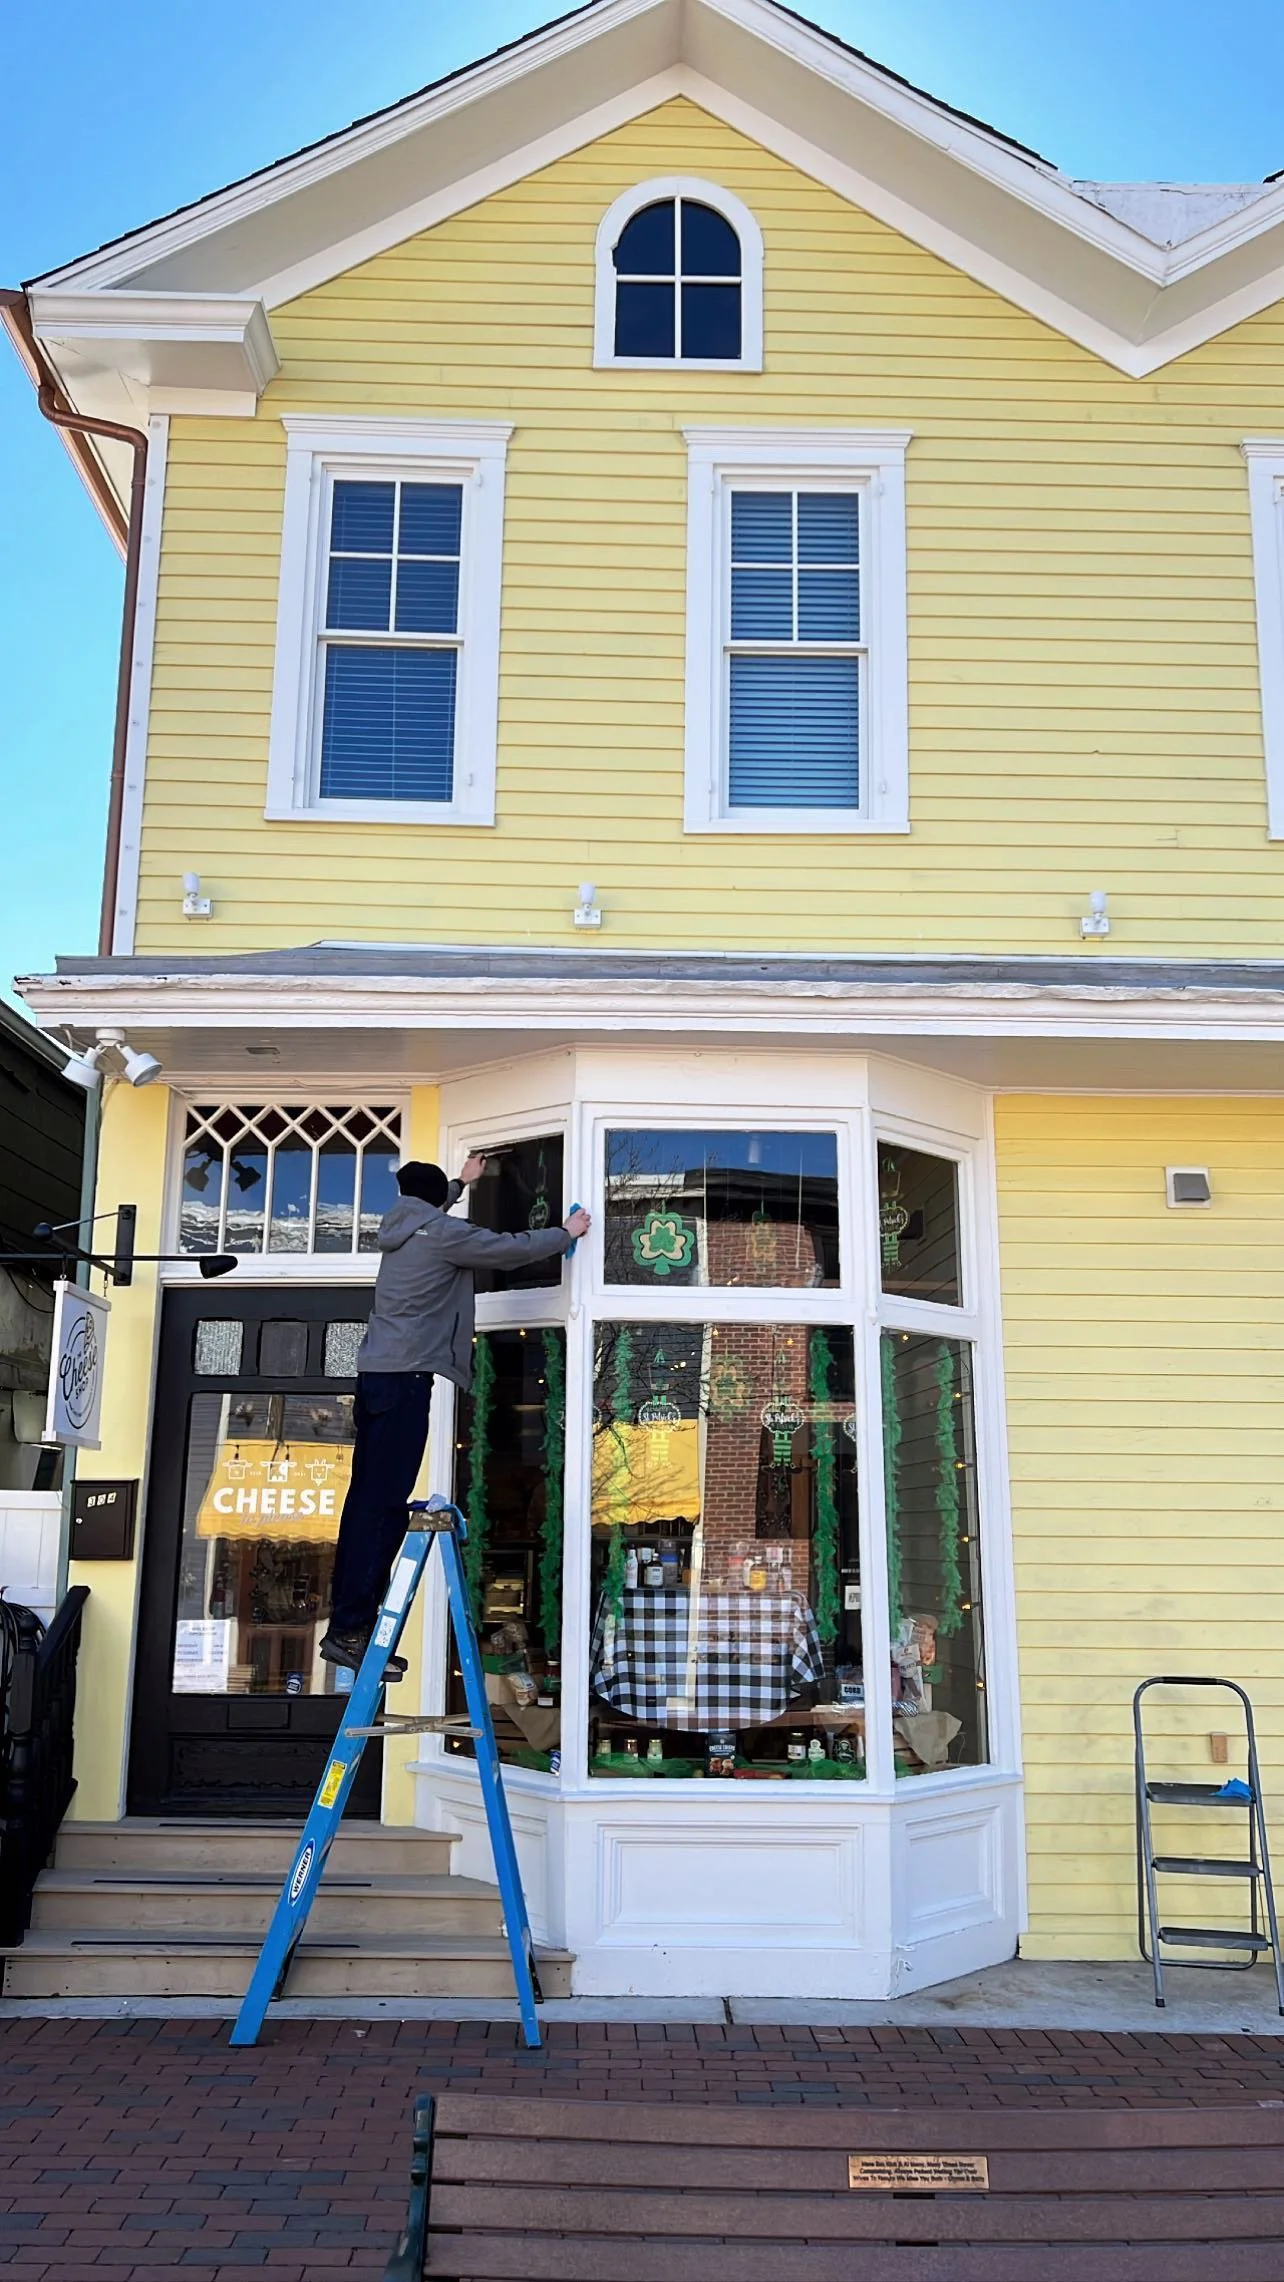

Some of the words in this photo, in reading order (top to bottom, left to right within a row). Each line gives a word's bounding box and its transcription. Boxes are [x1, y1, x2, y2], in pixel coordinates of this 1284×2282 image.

[59, 1345, 98, 1401] Cheese
[75, 1379, 89, 1400] SHOP
[212, 1487, 336, 1516] CHEESE
[292, 1851, 311, 1893] WERNER
